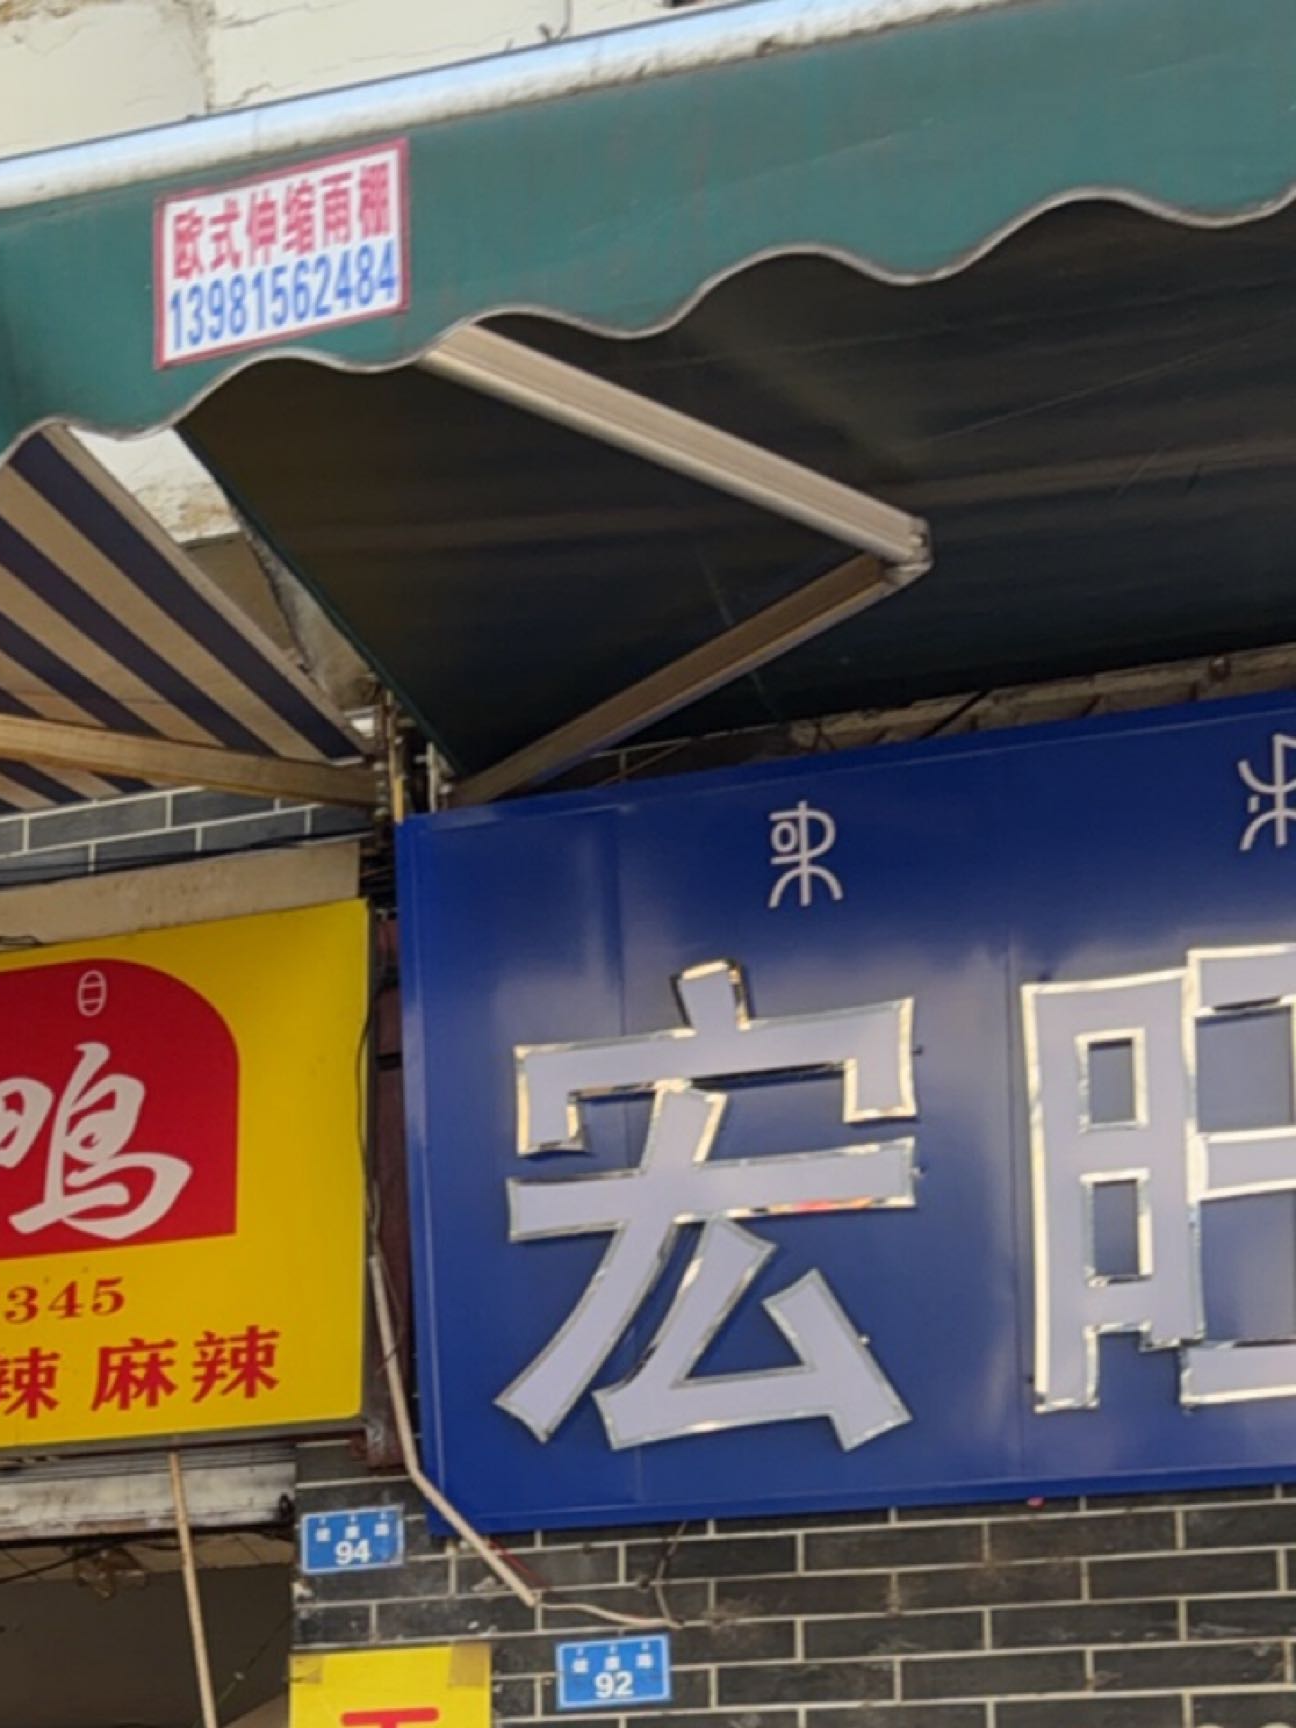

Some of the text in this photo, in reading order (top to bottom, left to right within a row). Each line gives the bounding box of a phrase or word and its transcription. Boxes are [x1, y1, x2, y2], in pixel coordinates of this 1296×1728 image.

[172, 161, 392, 280] 欧式伸缩雨棚
[169, 240, 397, 350] 13981562484
[494, 943, 1296, 1452] 宏旺
[92, 1325, 280, 1412] 麻辣
[335, 1539, 371, 1565] 94
[595, 1671, 635, 1698] 92
